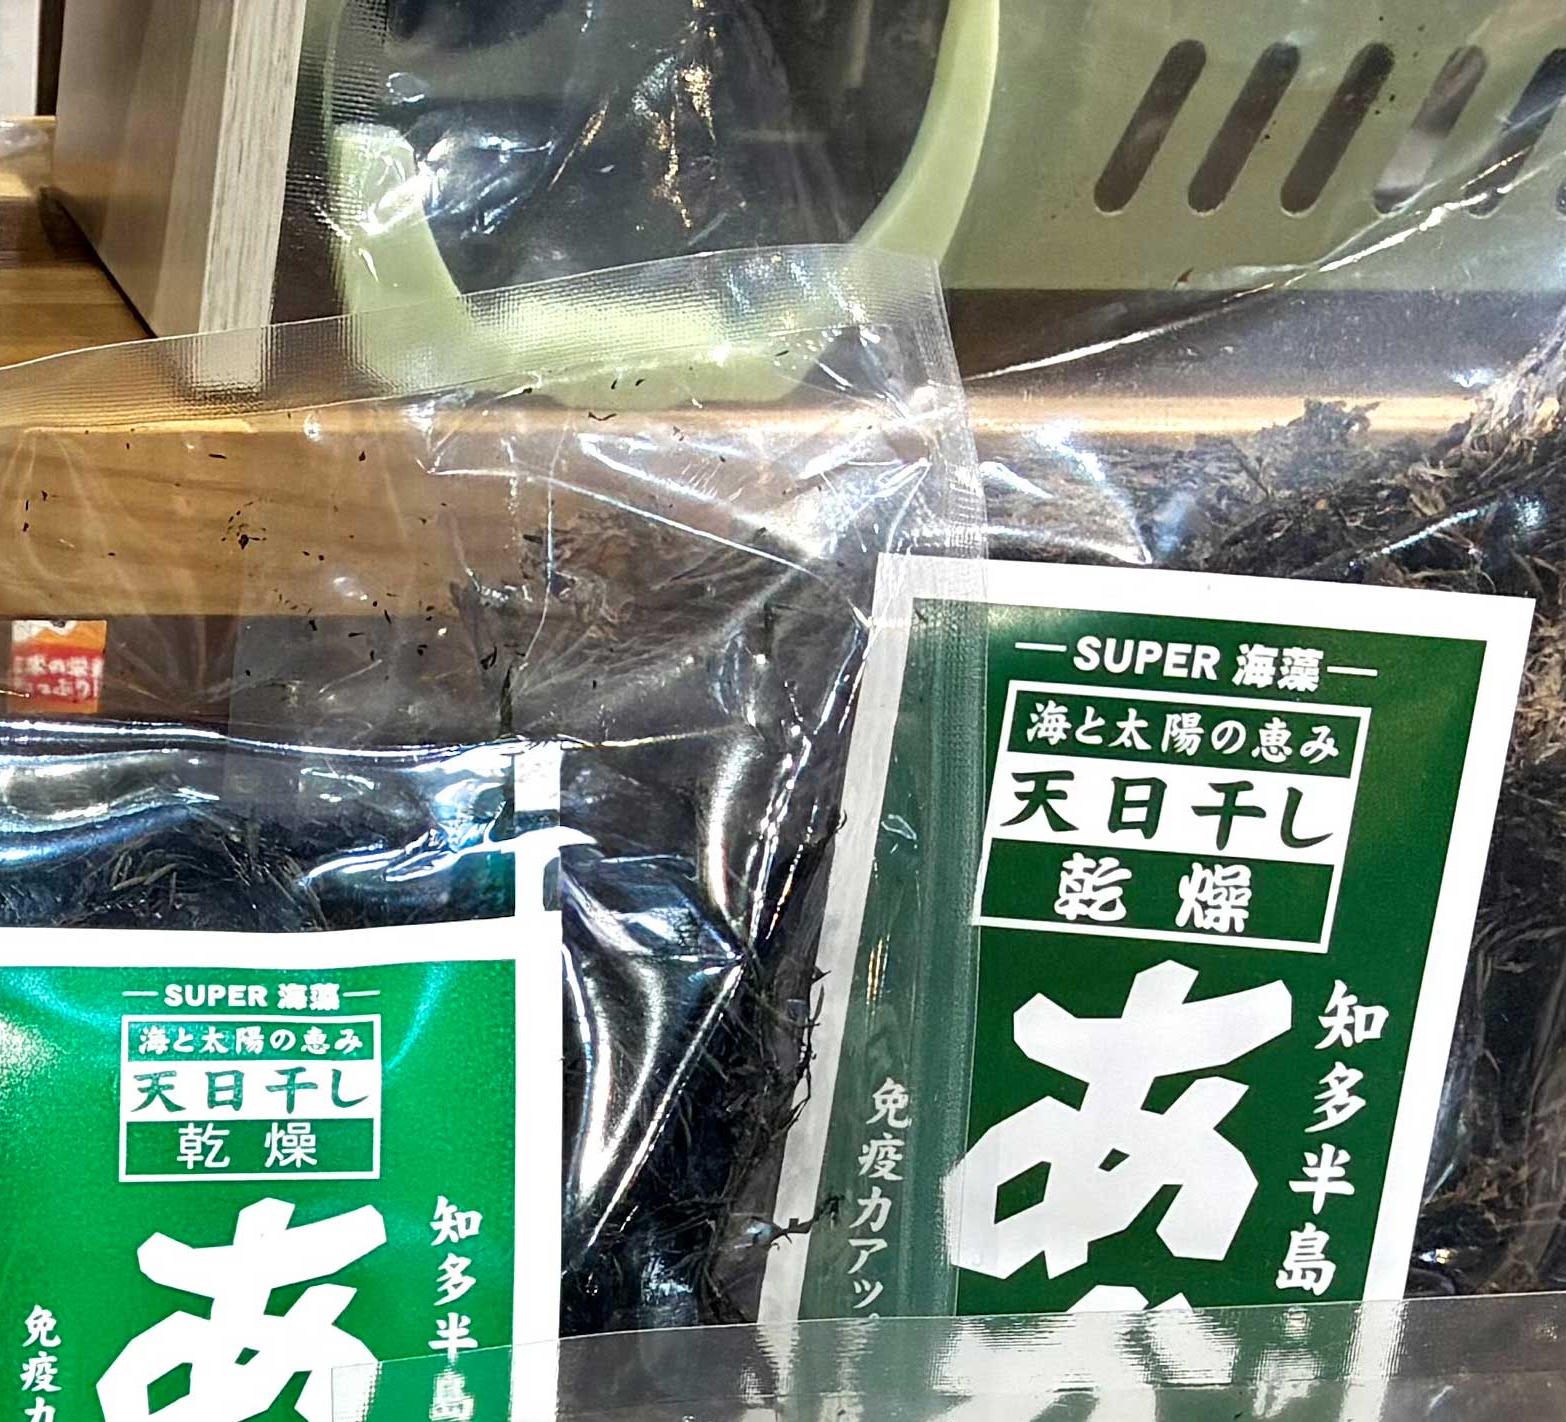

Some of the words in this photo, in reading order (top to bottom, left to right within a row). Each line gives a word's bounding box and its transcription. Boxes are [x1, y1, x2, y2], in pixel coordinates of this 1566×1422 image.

[1072, 636, 1220, 682] SUPER
[1234, 642, 1325, 694] 海藻
[1025, 700, 1341, 764] 海と太陽の恵み
[999, 768, 1335, 851] 天日干し
[1054, 851, 1254, 934] 乾燥
[163, 983, 268, 1009] SUPER
[277, 983, 341, 1011] 海藻
[138, 1027, 364, 1055] 海と太陽の恵み
[129, 1065, 370, 1115] 天日干し
[176, 1121, 320, 1170] 乾燥
